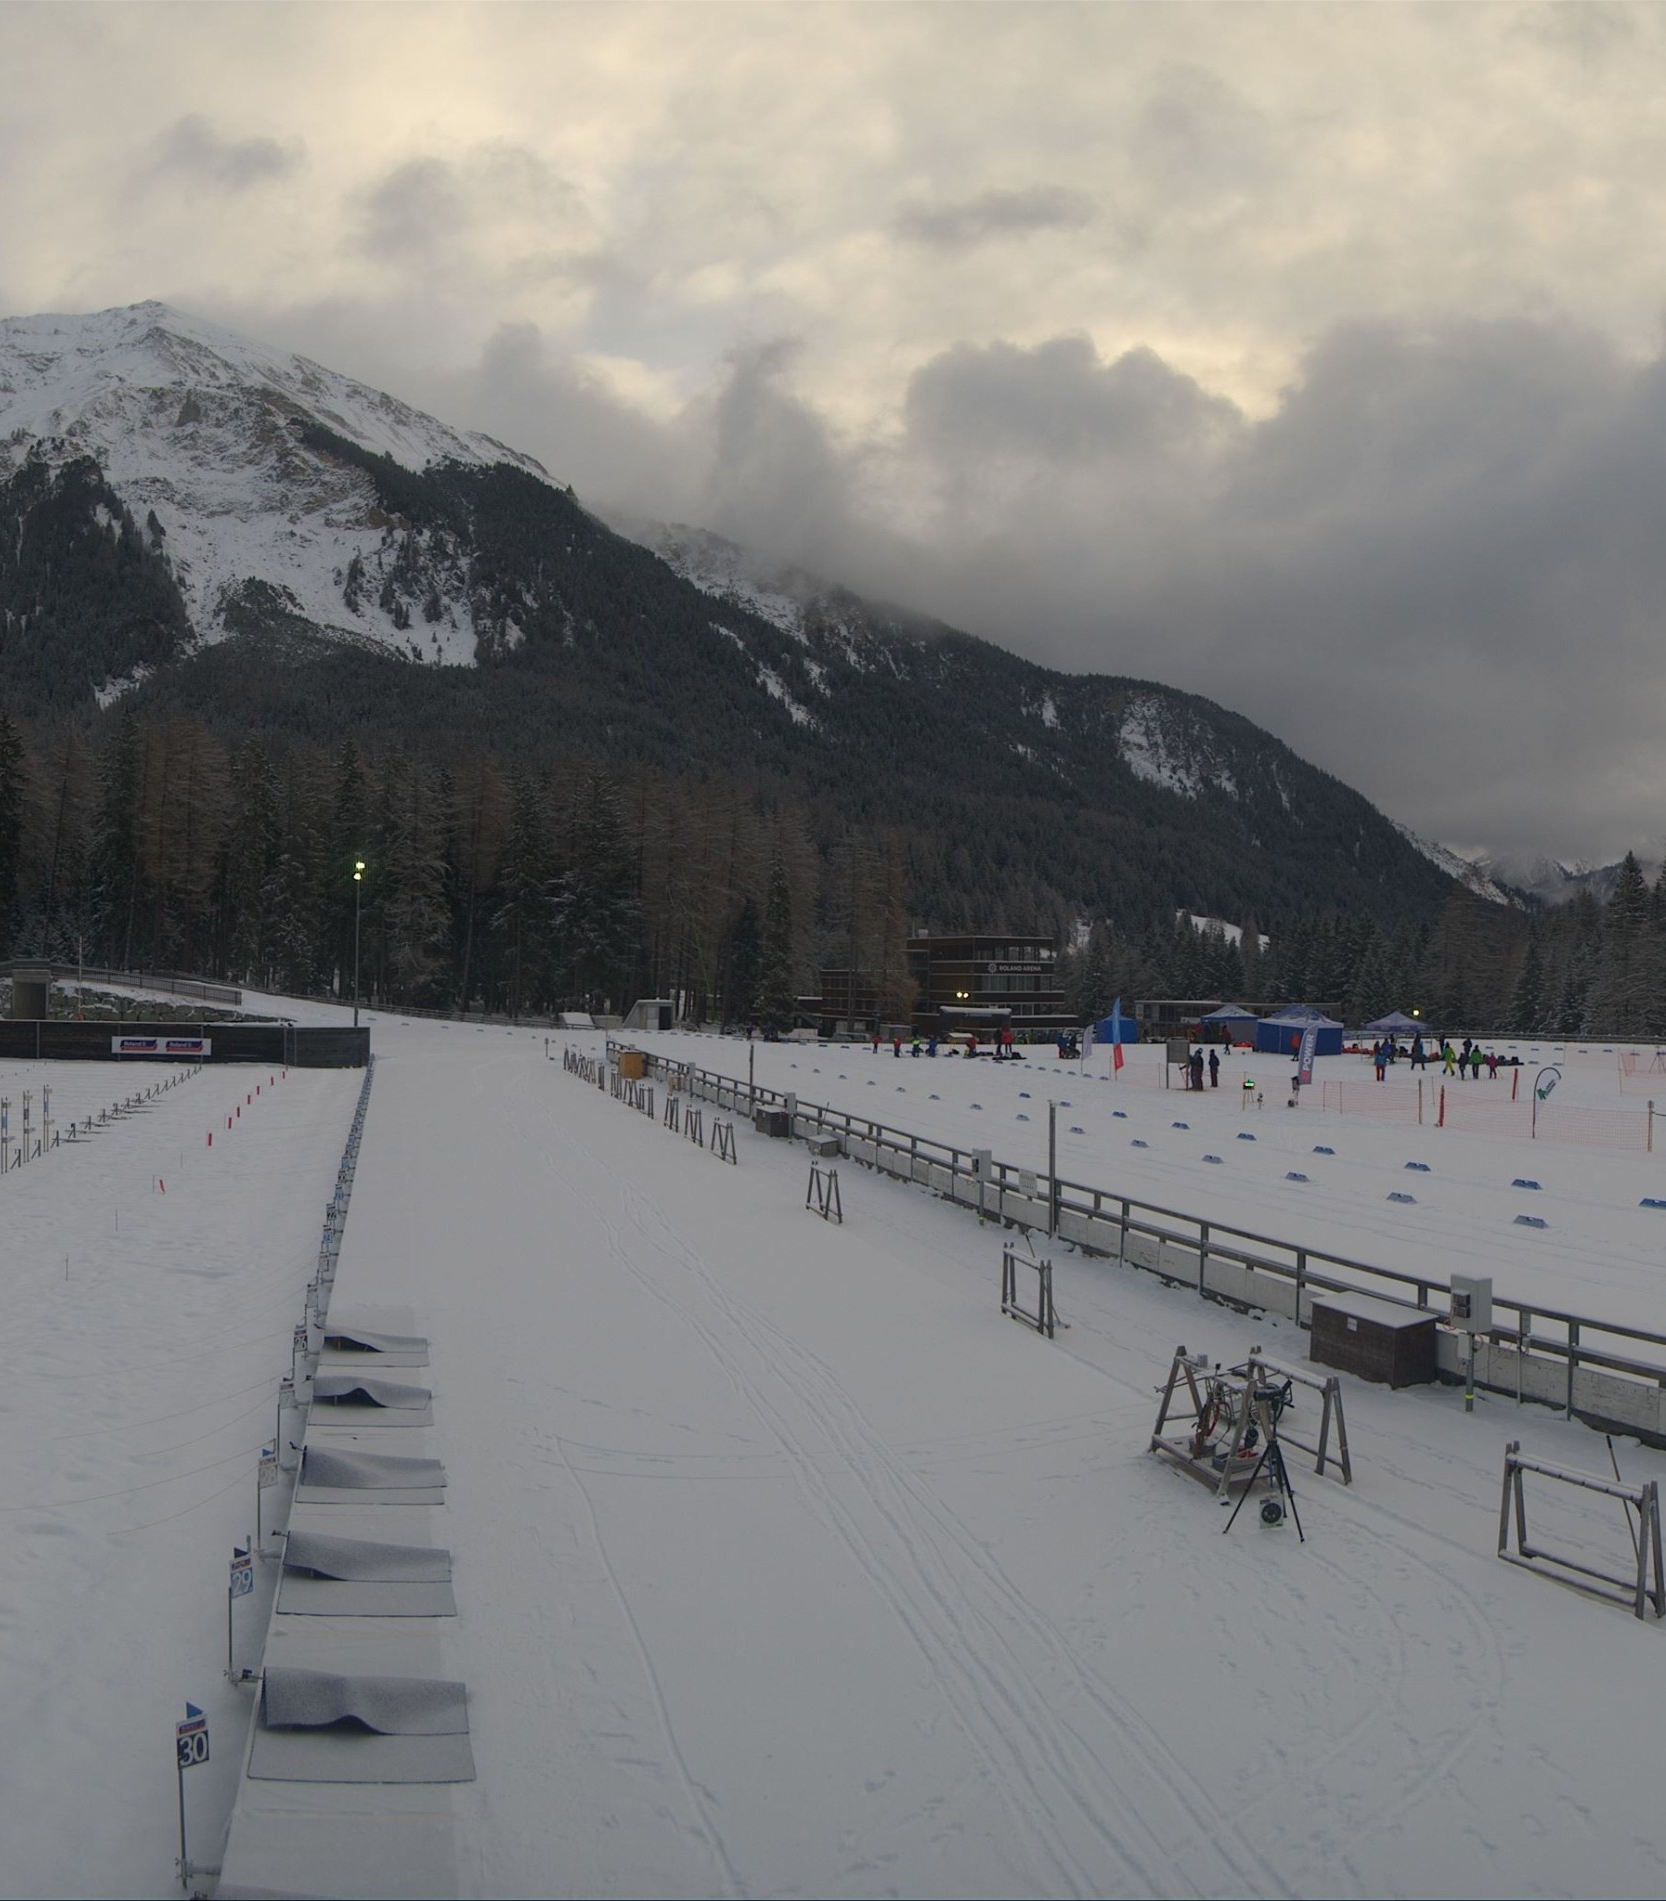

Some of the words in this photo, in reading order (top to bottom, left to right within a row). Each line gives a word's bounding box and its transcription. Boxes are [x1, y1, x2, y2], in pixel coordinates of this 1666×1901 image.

[1303, 1034, 1315, 1071] POWER
[260, 1467, 277, 1485] 28
[232, 1568, 252, 1597] 29
[179, 1732, 208, 1766] 30
